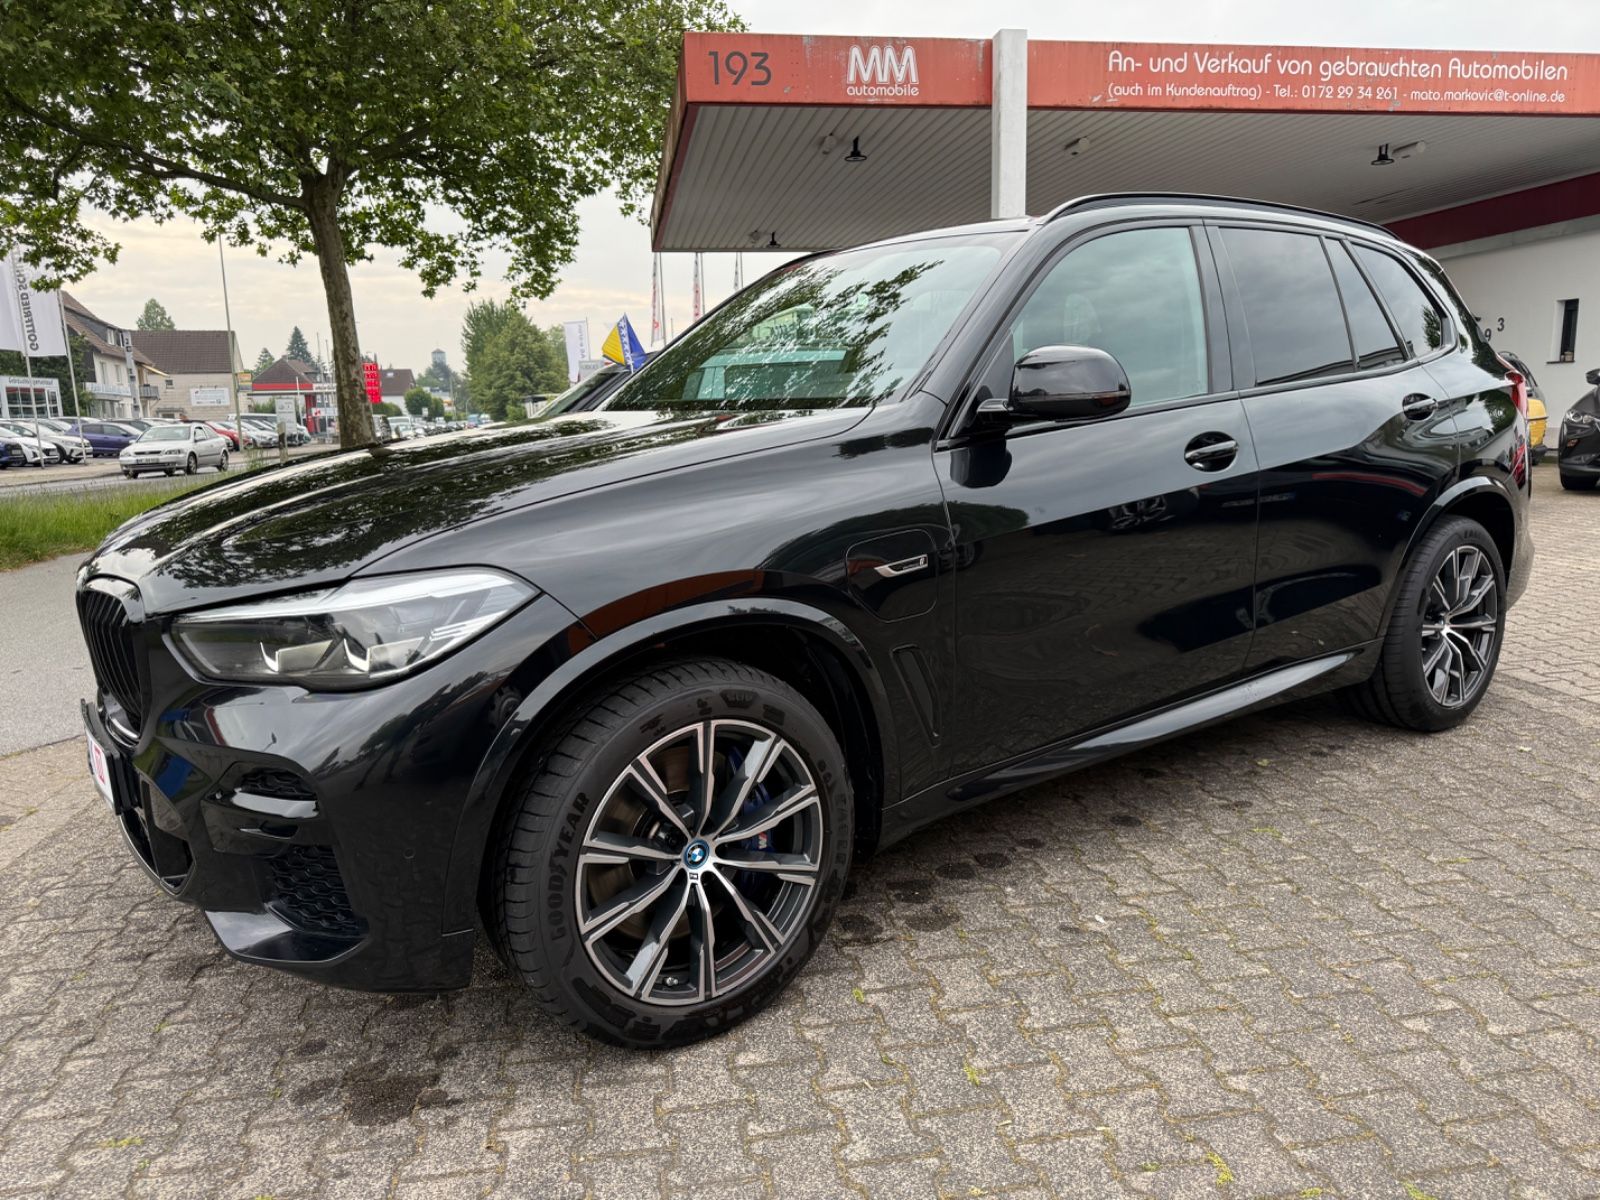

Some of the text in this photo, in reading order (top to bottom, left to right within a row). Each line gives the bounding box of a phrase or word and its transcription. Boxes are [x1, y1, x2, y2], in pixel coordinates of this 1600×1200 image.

[708, 51, 772, 86] 193
[847, 45, 920, 85] MM
[1108, 50, 1568, 81] An- und Verkauf von gebrauchten Automobilen
[847, 84, 920, 96] automobile
[1108, 83, 1142, 98] (auch
[1148, 84, 1162, 96] im
[1166, 84, 1262, 100] Kundenauftrag)
[1273, 85, 1298, 98] Tel.:
[1302, 85, 1334, 98] 0172
[1337, 86, 1354, 99] 29
[1357, 86, 1372, 99] 34
[1376, 87, 1398, 100] 261
[1410, 89, 1566, 103] mato.markovic@t-online.de
[547, 792, 591, 941] GOODYEAR
